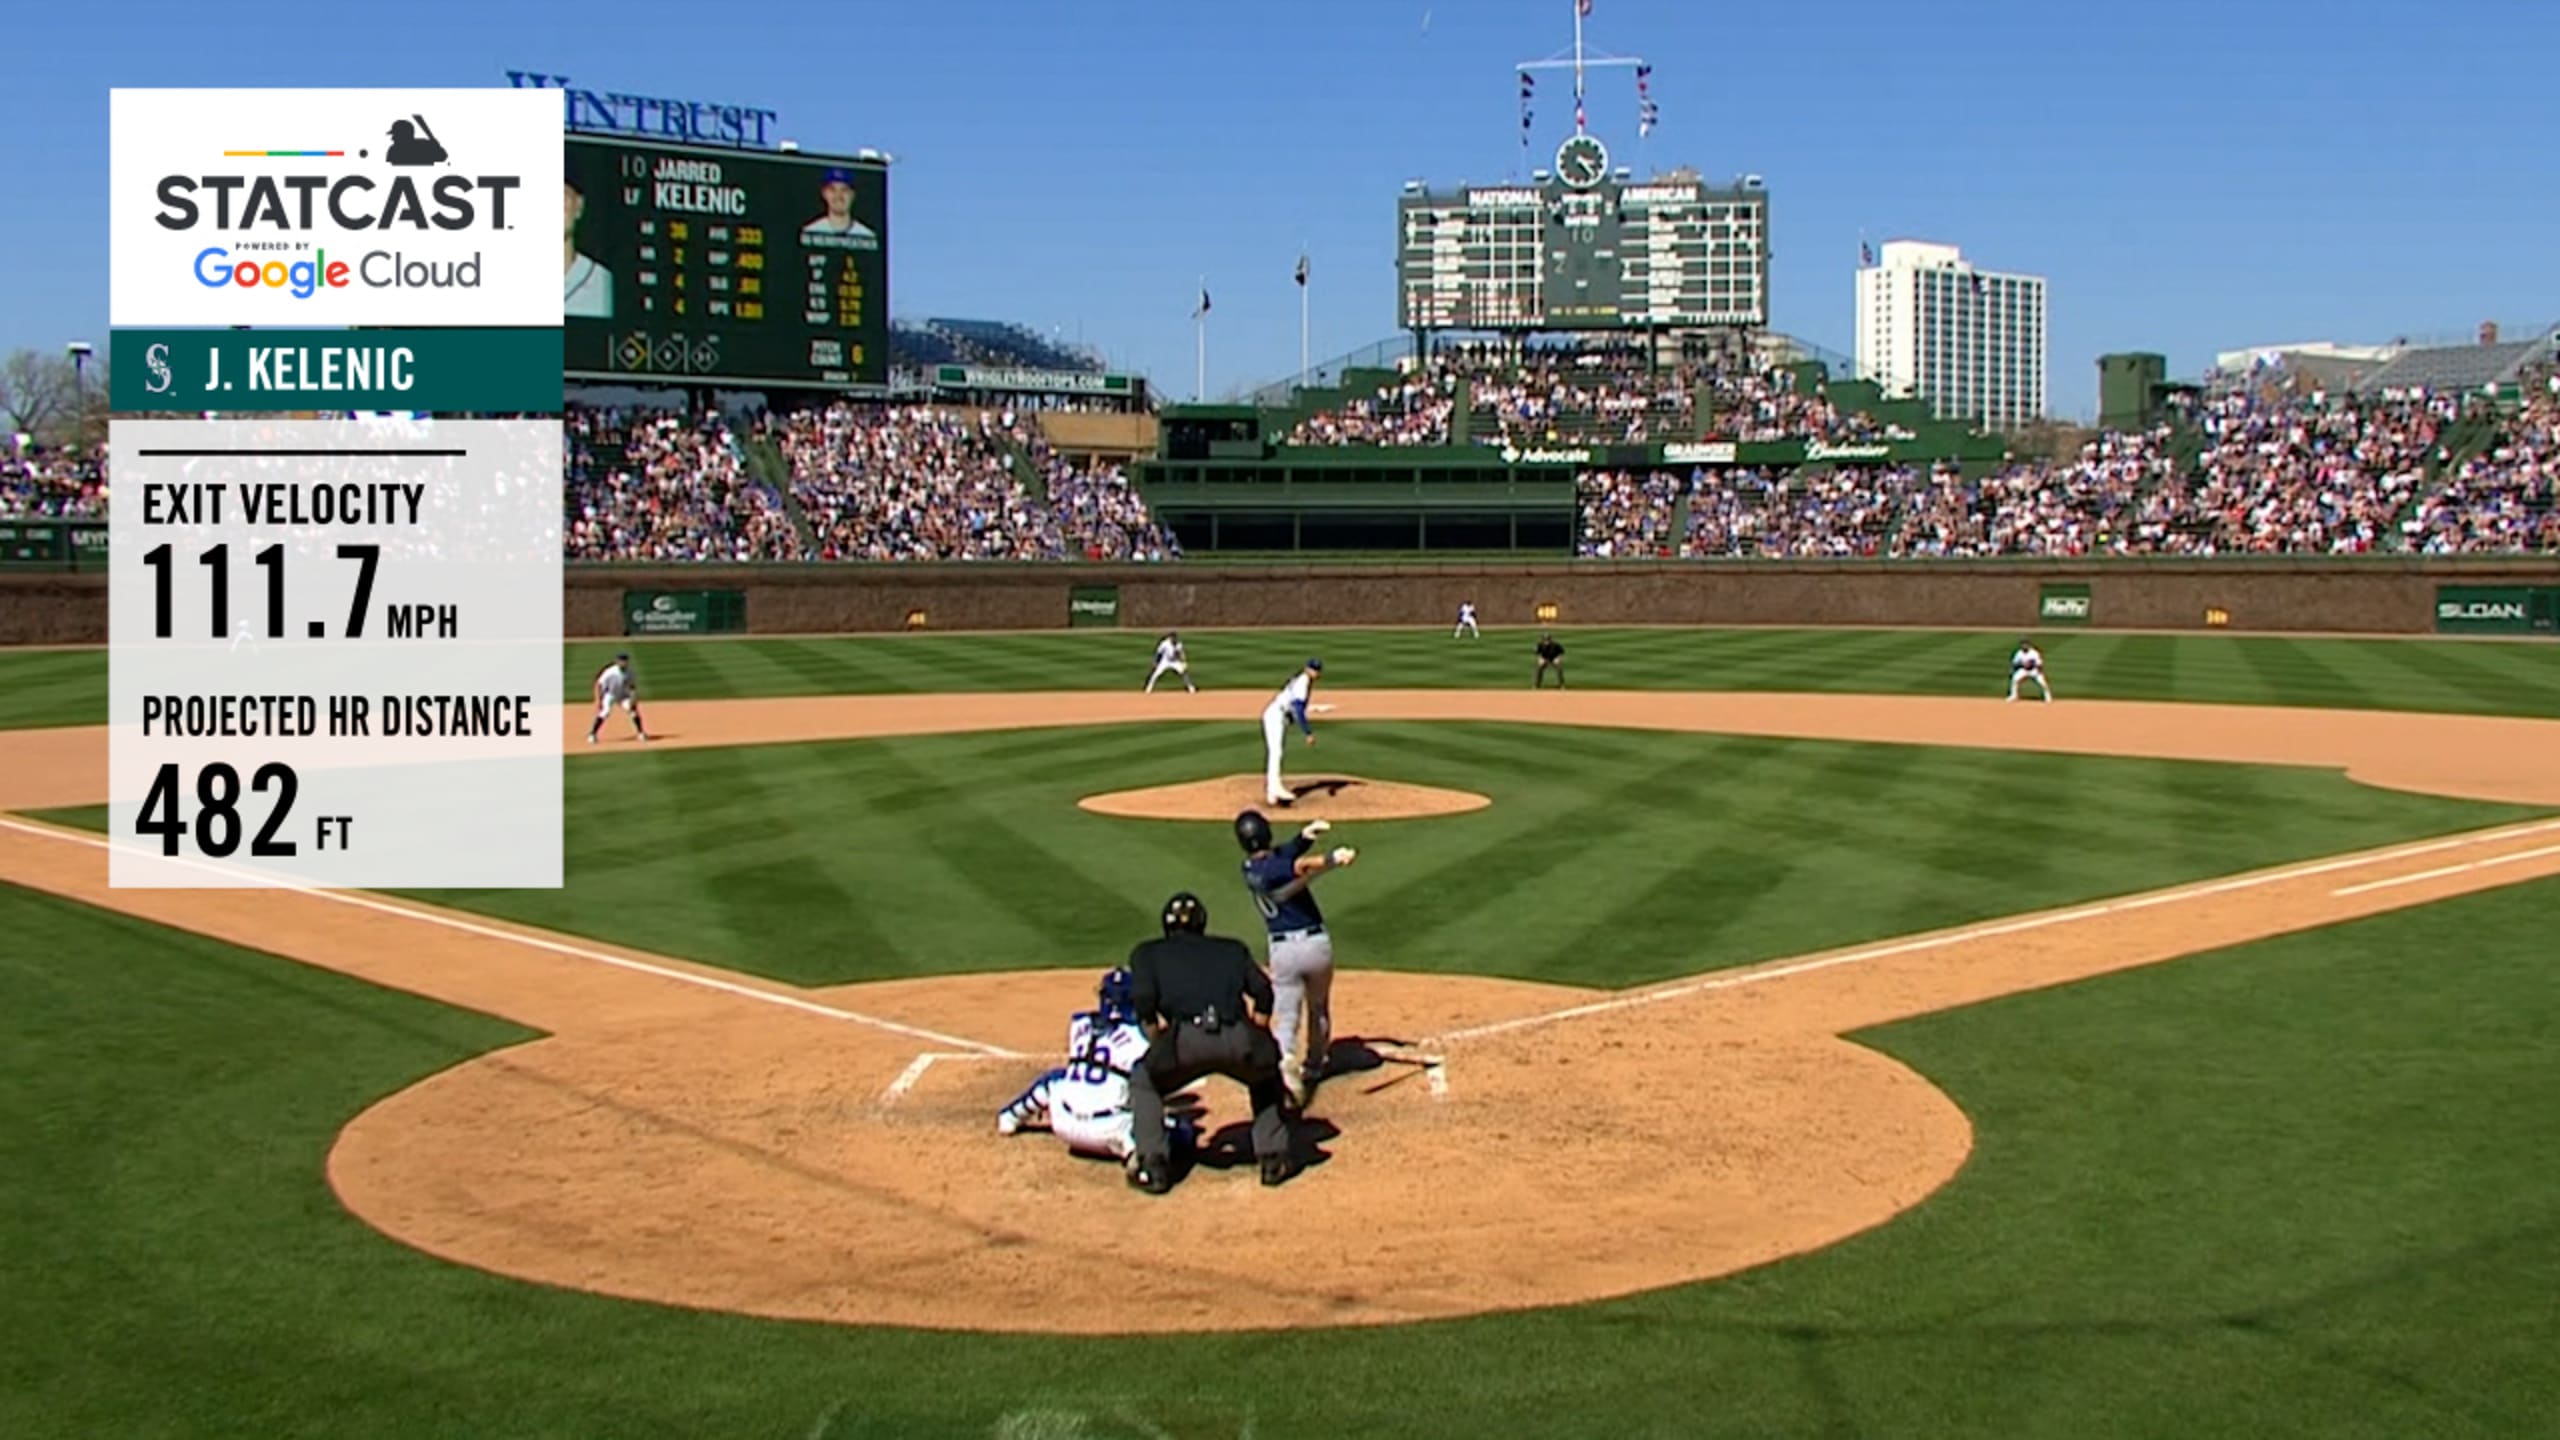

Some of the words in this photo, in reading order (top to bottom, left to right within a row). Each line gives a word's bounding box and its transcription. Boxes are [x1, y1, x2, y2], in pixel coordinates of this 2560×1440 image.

[653, 158, 722, 184] JARRED
[655, 182, 746, 215] KELENIC
[1469, 191, 1545, 206] NATIONAL
[1620, 187, 1697, 204] AMERICAN
[1521, 445, 1590, 463] Advocate
[2438, 603, 2525, 618] SLOAN
[1070, 1043, 1111, 1085] 18
